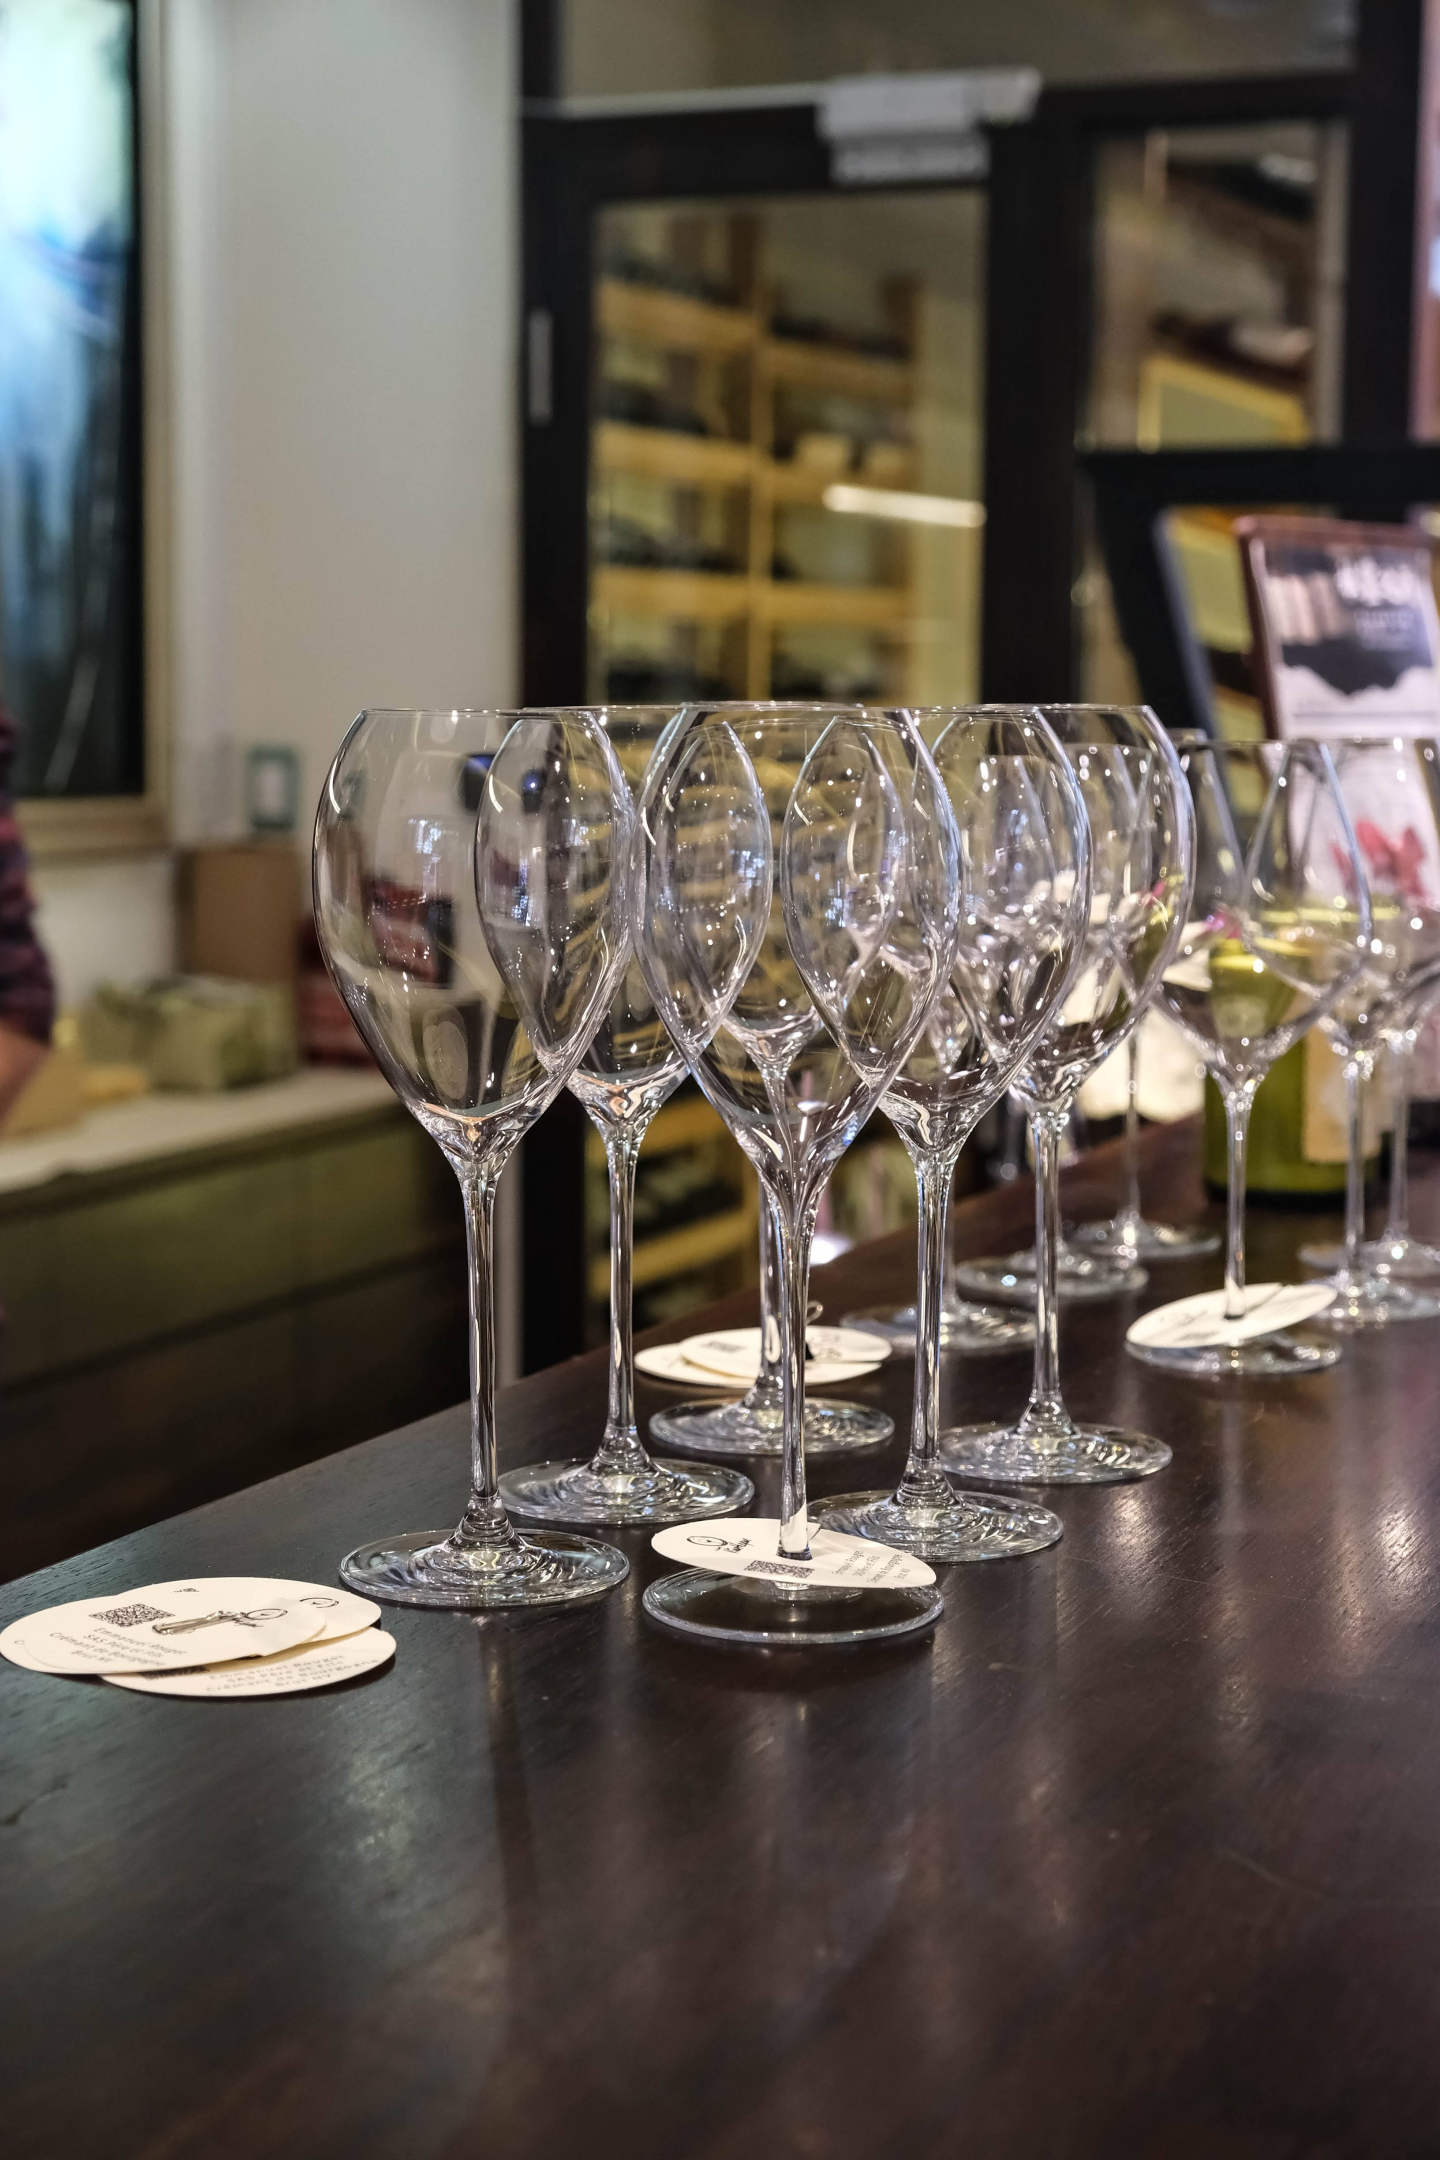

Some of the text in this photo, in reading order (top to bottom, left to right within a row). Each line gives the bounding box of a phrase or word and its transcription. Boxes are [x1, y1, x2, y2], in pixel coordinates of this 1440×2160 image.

[83, 1634, 108, 1643] SAS
[93, 1627, 151, 1646] Emmanuel
[71, 1650, 97, 1659] Brut
[274, 1679, 308, 1687] Brut
